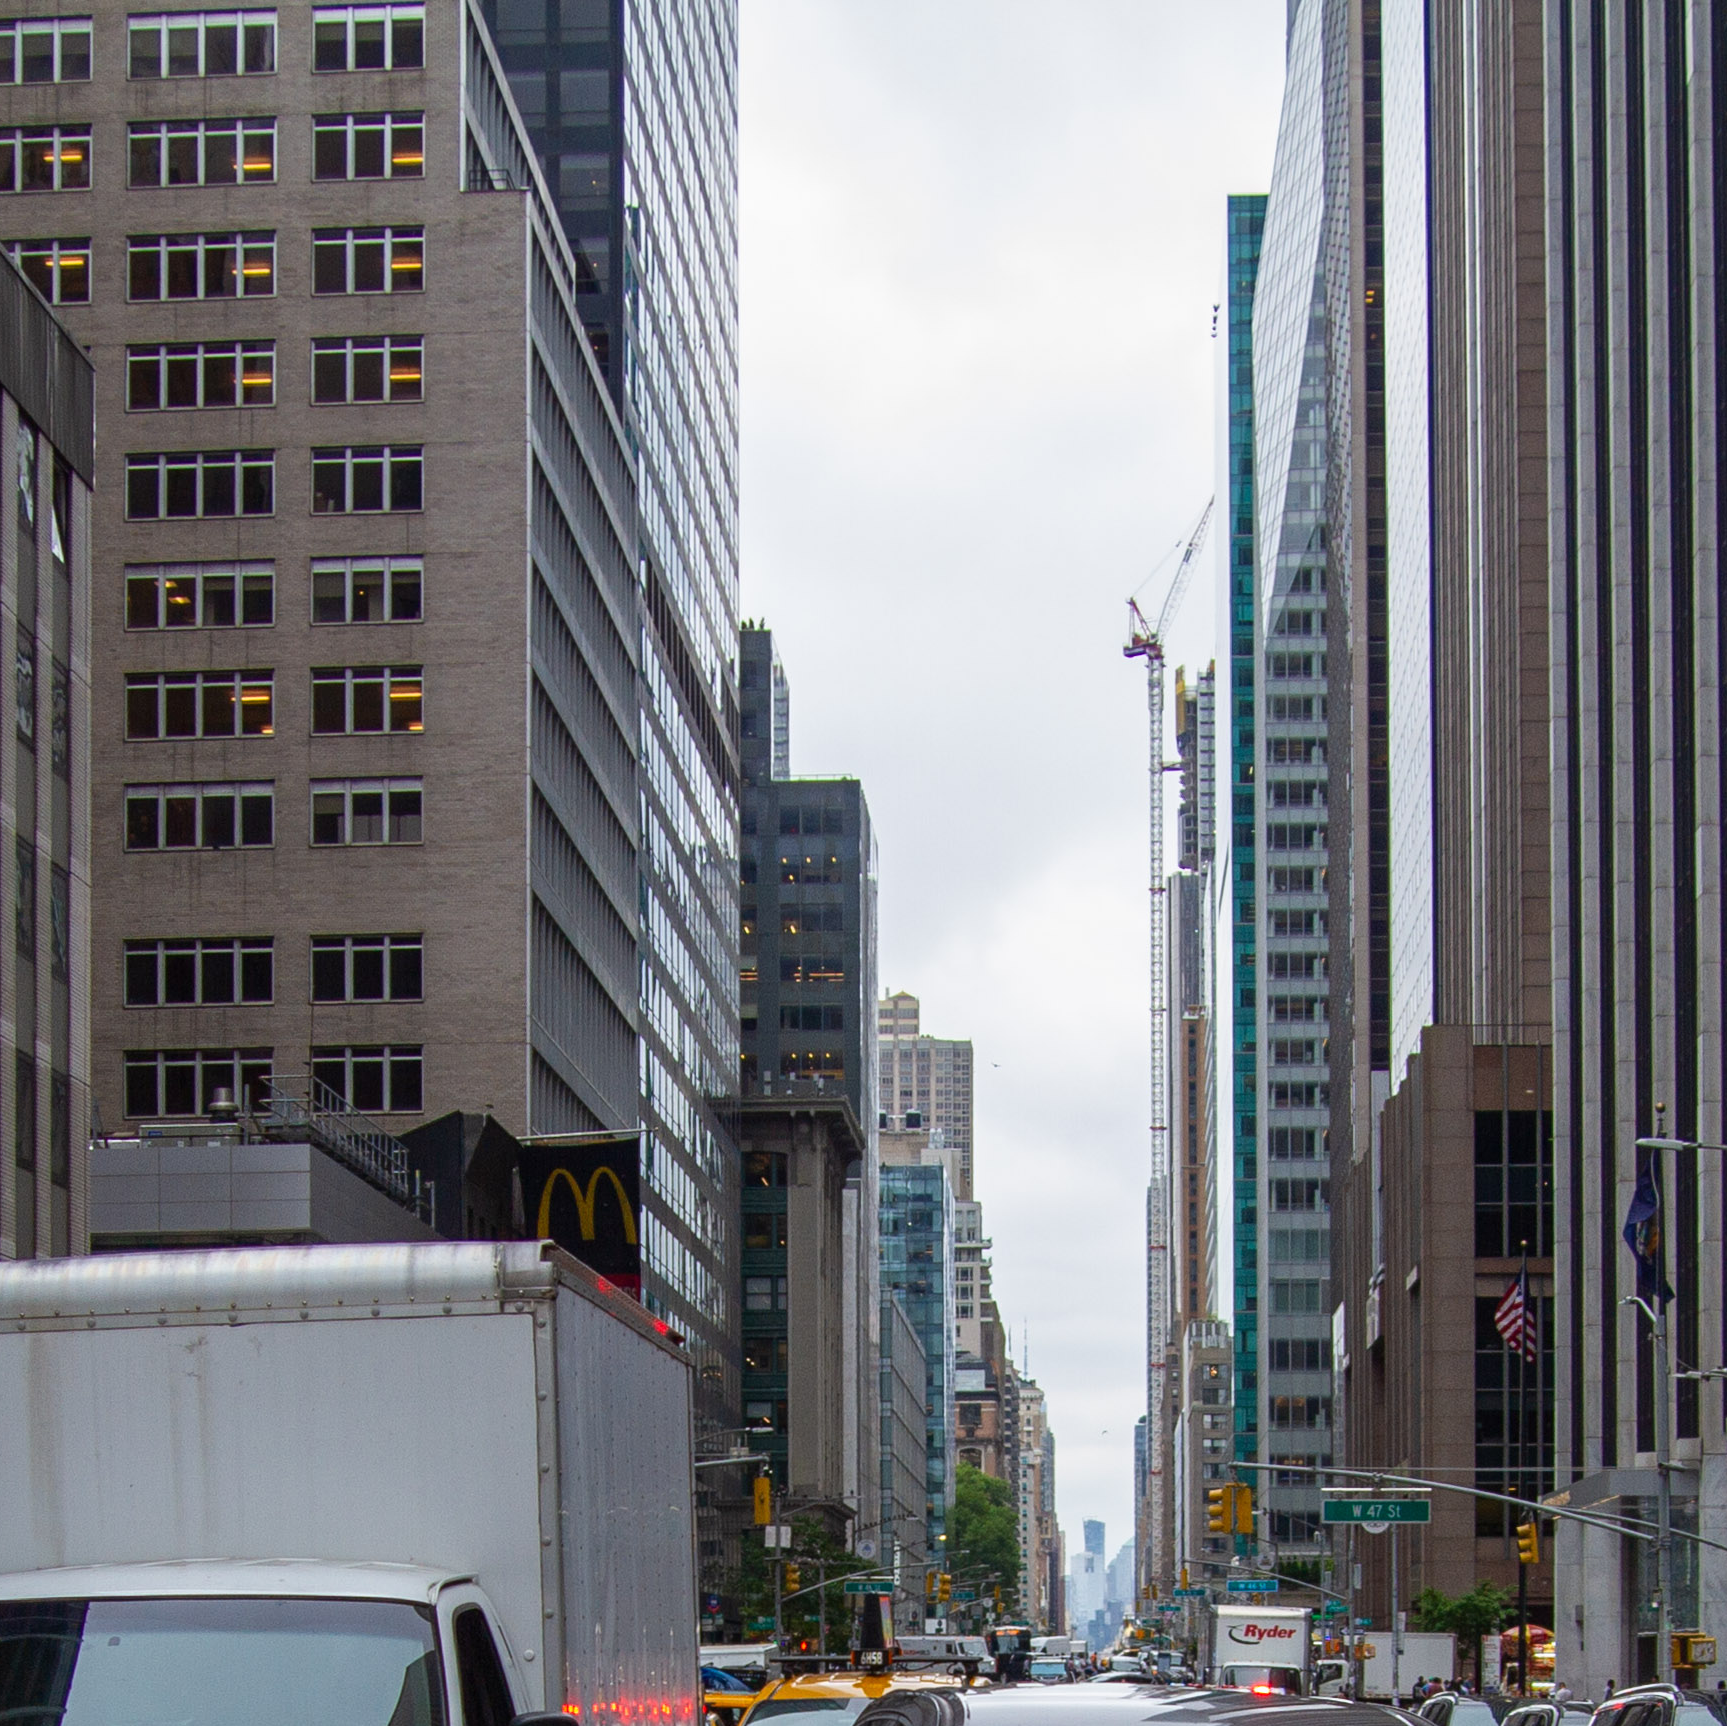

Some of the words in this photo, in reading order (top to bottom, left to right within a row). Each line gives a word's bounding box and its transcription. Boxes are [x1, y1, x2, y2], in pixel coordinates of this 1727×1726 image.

[1352, 1505, 1362, 1518] W
[1367, 1505, 1382, 1518] 47
[1387, 1505, 1401, 1518] St
[1244, 1624, 1297, 1641] Ryder
[861, 1652, 883, 1665] 6H58
